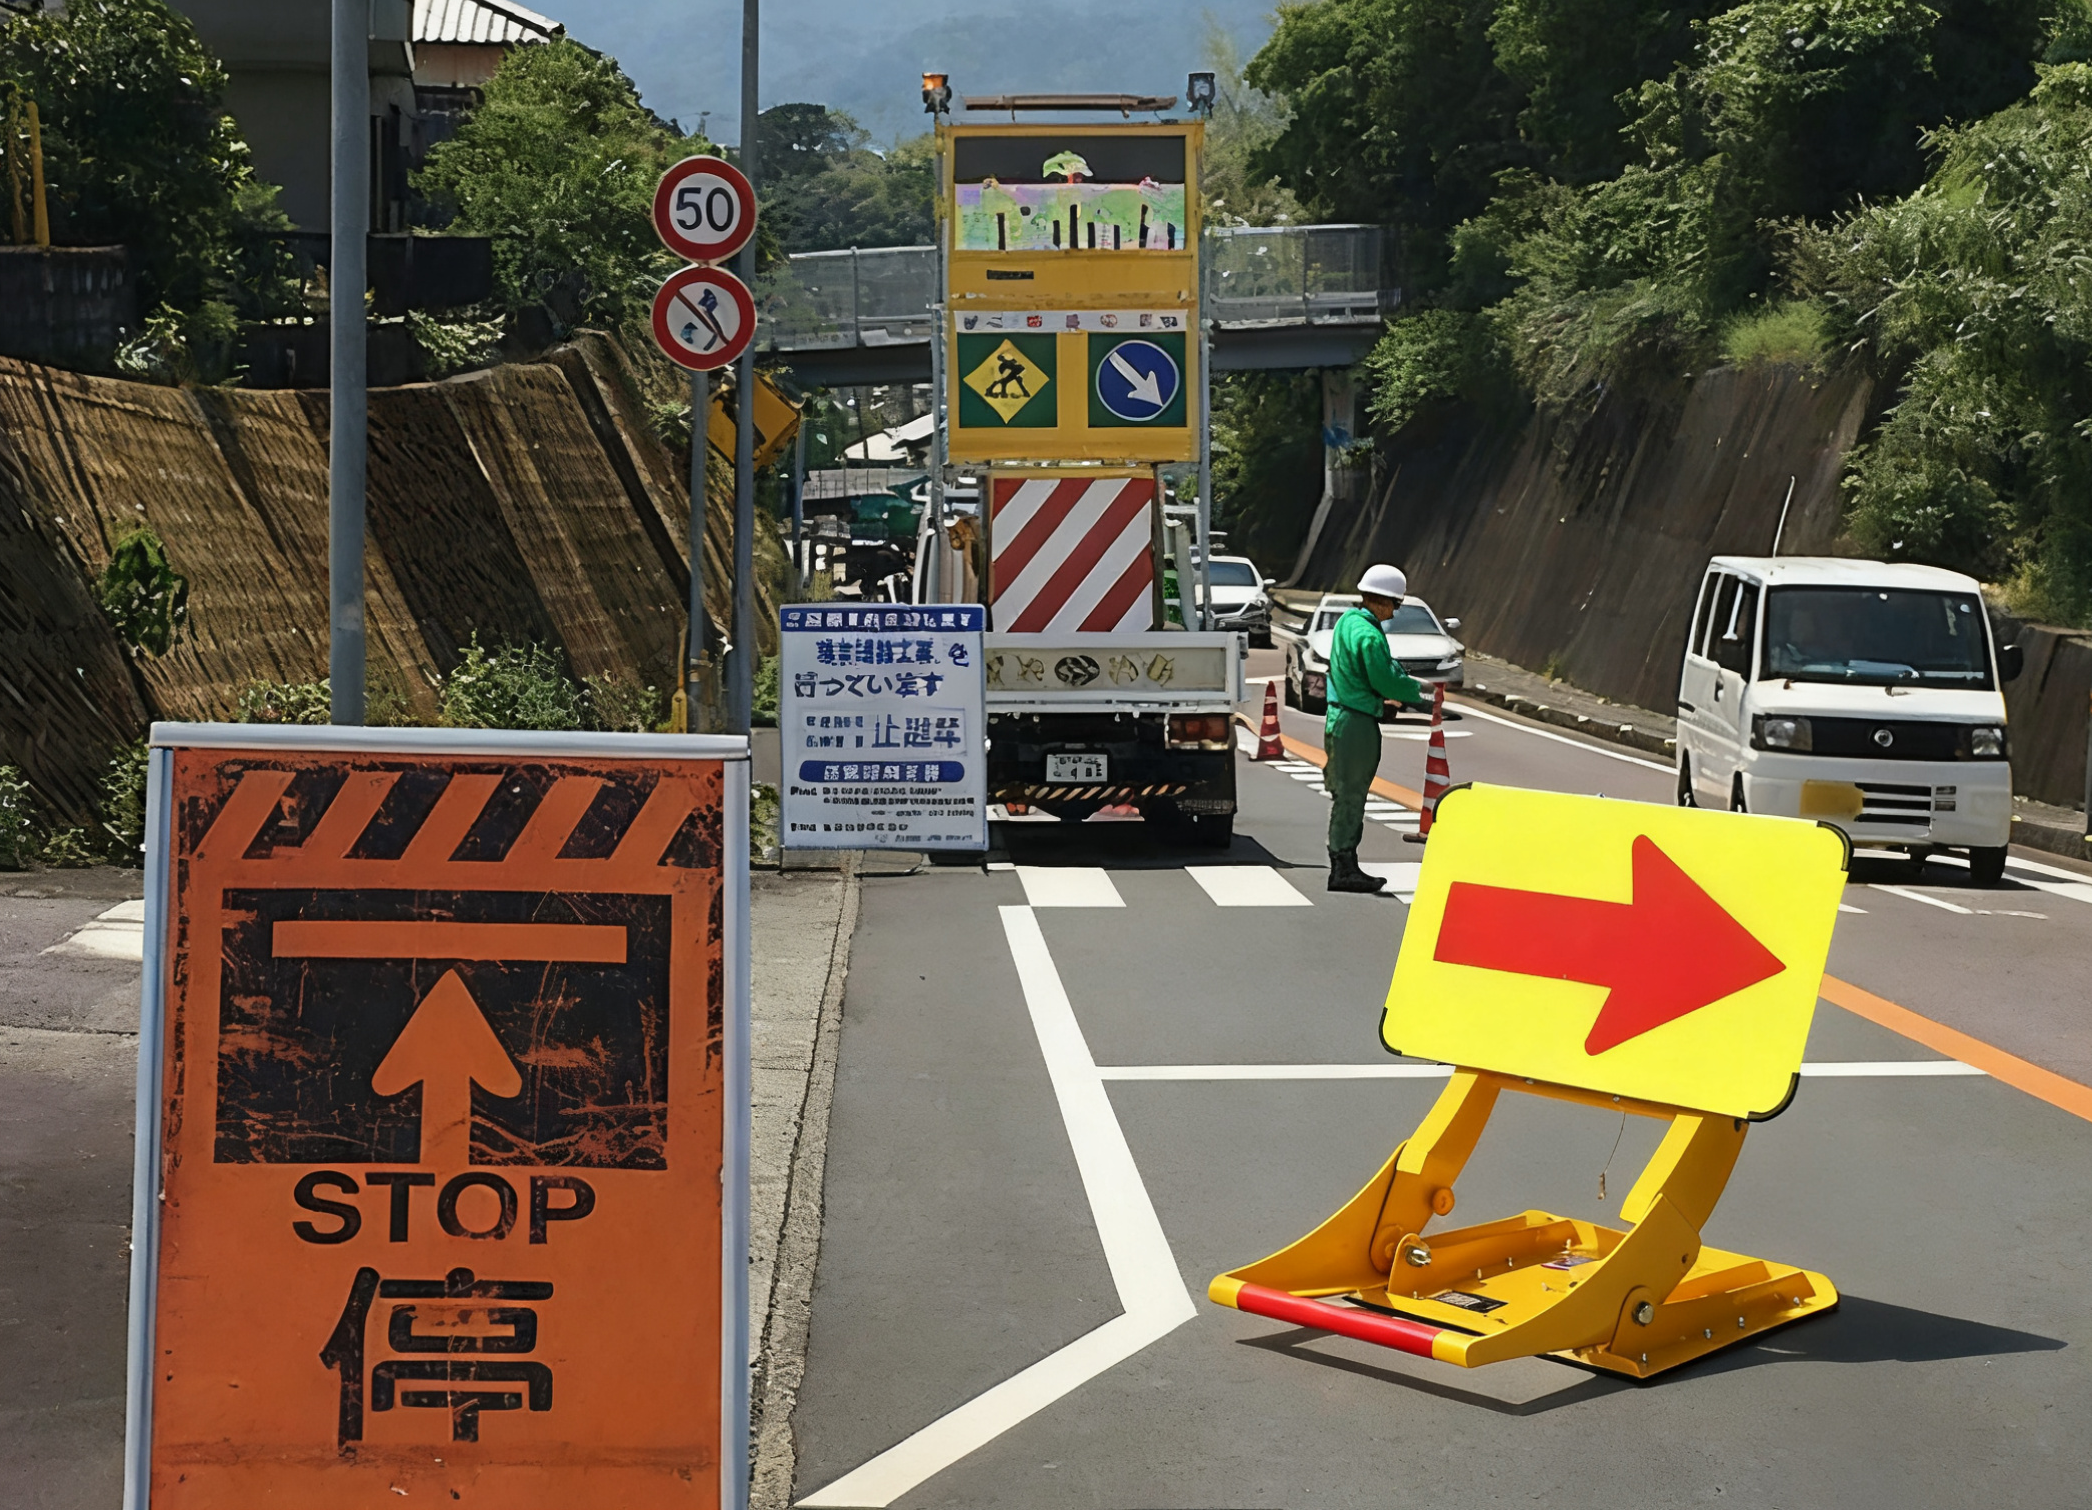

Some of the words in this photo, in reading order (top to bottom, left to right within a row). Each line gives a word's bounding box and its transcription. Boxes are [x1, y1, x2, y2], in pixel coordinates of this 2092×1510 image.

[676, 187, 734, 232] 50
[292, 1170, 596, 1244] STOP
[319, 1266, 554, 1444] 停
